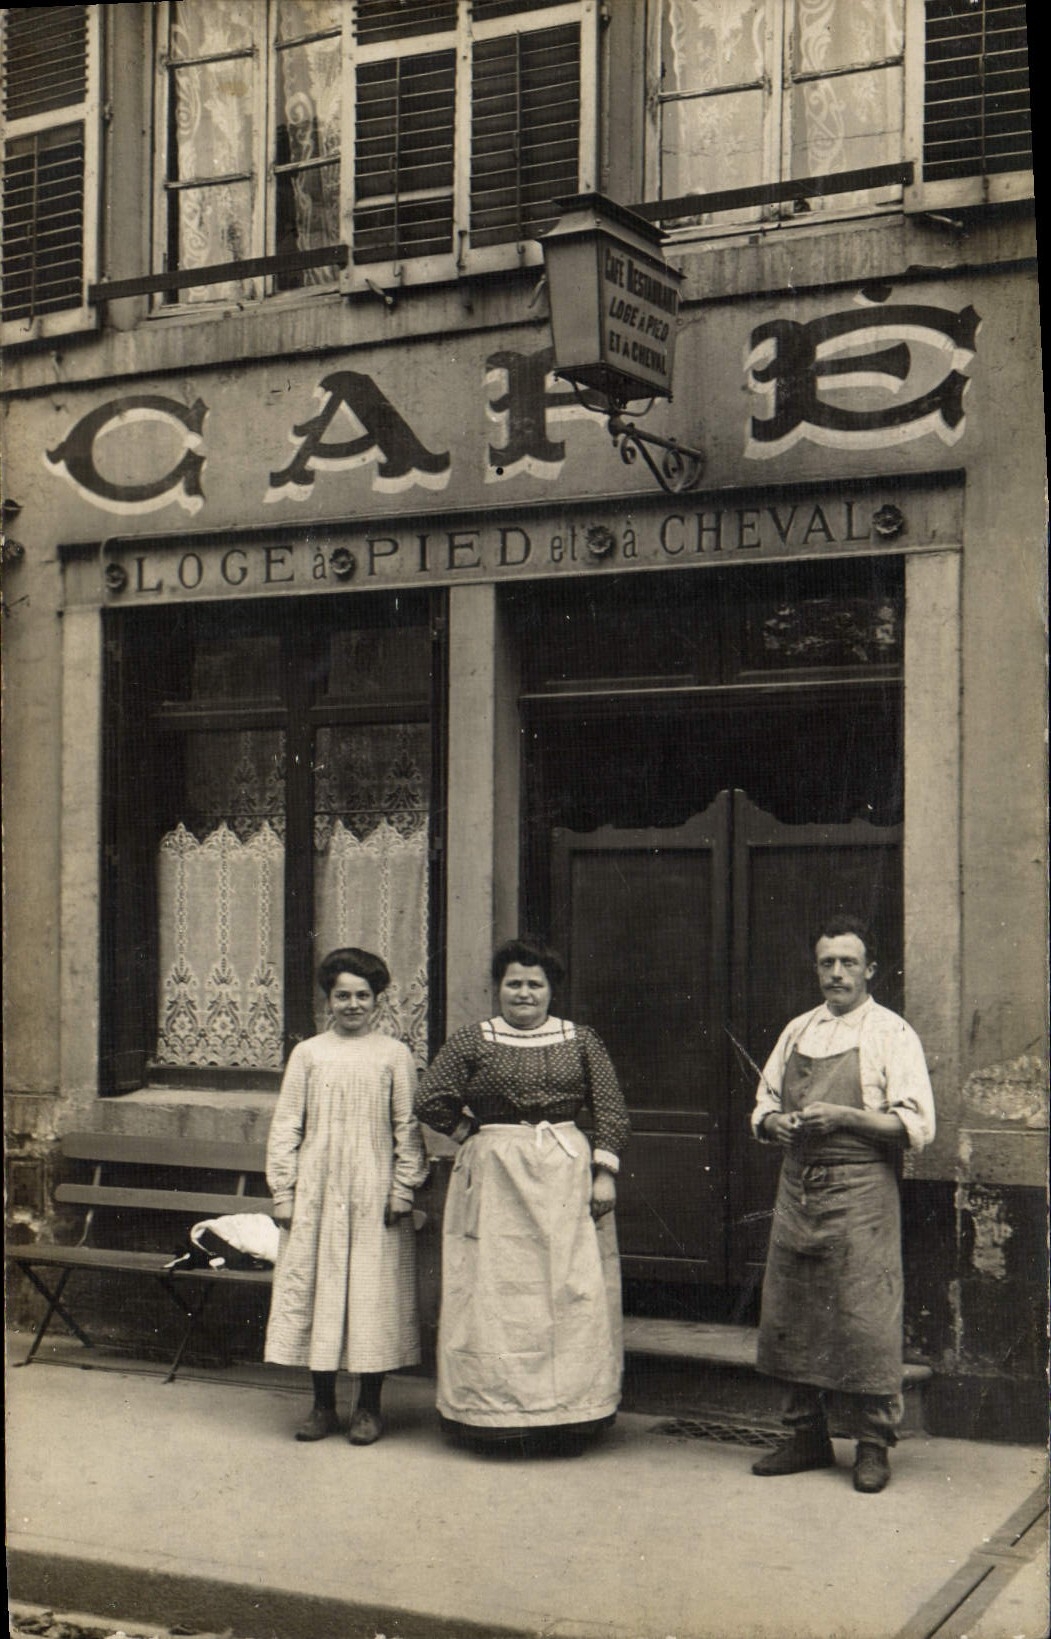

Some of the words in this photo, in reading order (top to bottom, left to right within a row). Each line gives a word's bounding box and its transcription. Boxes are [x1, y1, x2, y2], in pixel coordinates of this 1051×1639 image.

[609, 296, 639, 328] LOGE
[646, 317, 669, 342] PIED
[609, 331, 621, 354] ET
[631, 344, 667, 375] CHEVAL
[135, 545, 295, 593] LOGE
[312, 546, 328, 580] à
[366, 526, 531, 577] PIED
[550, 529, 577, 563] et
[623, 523, 638, 558] à
[659, 501, 872, 555] CHEVAL
